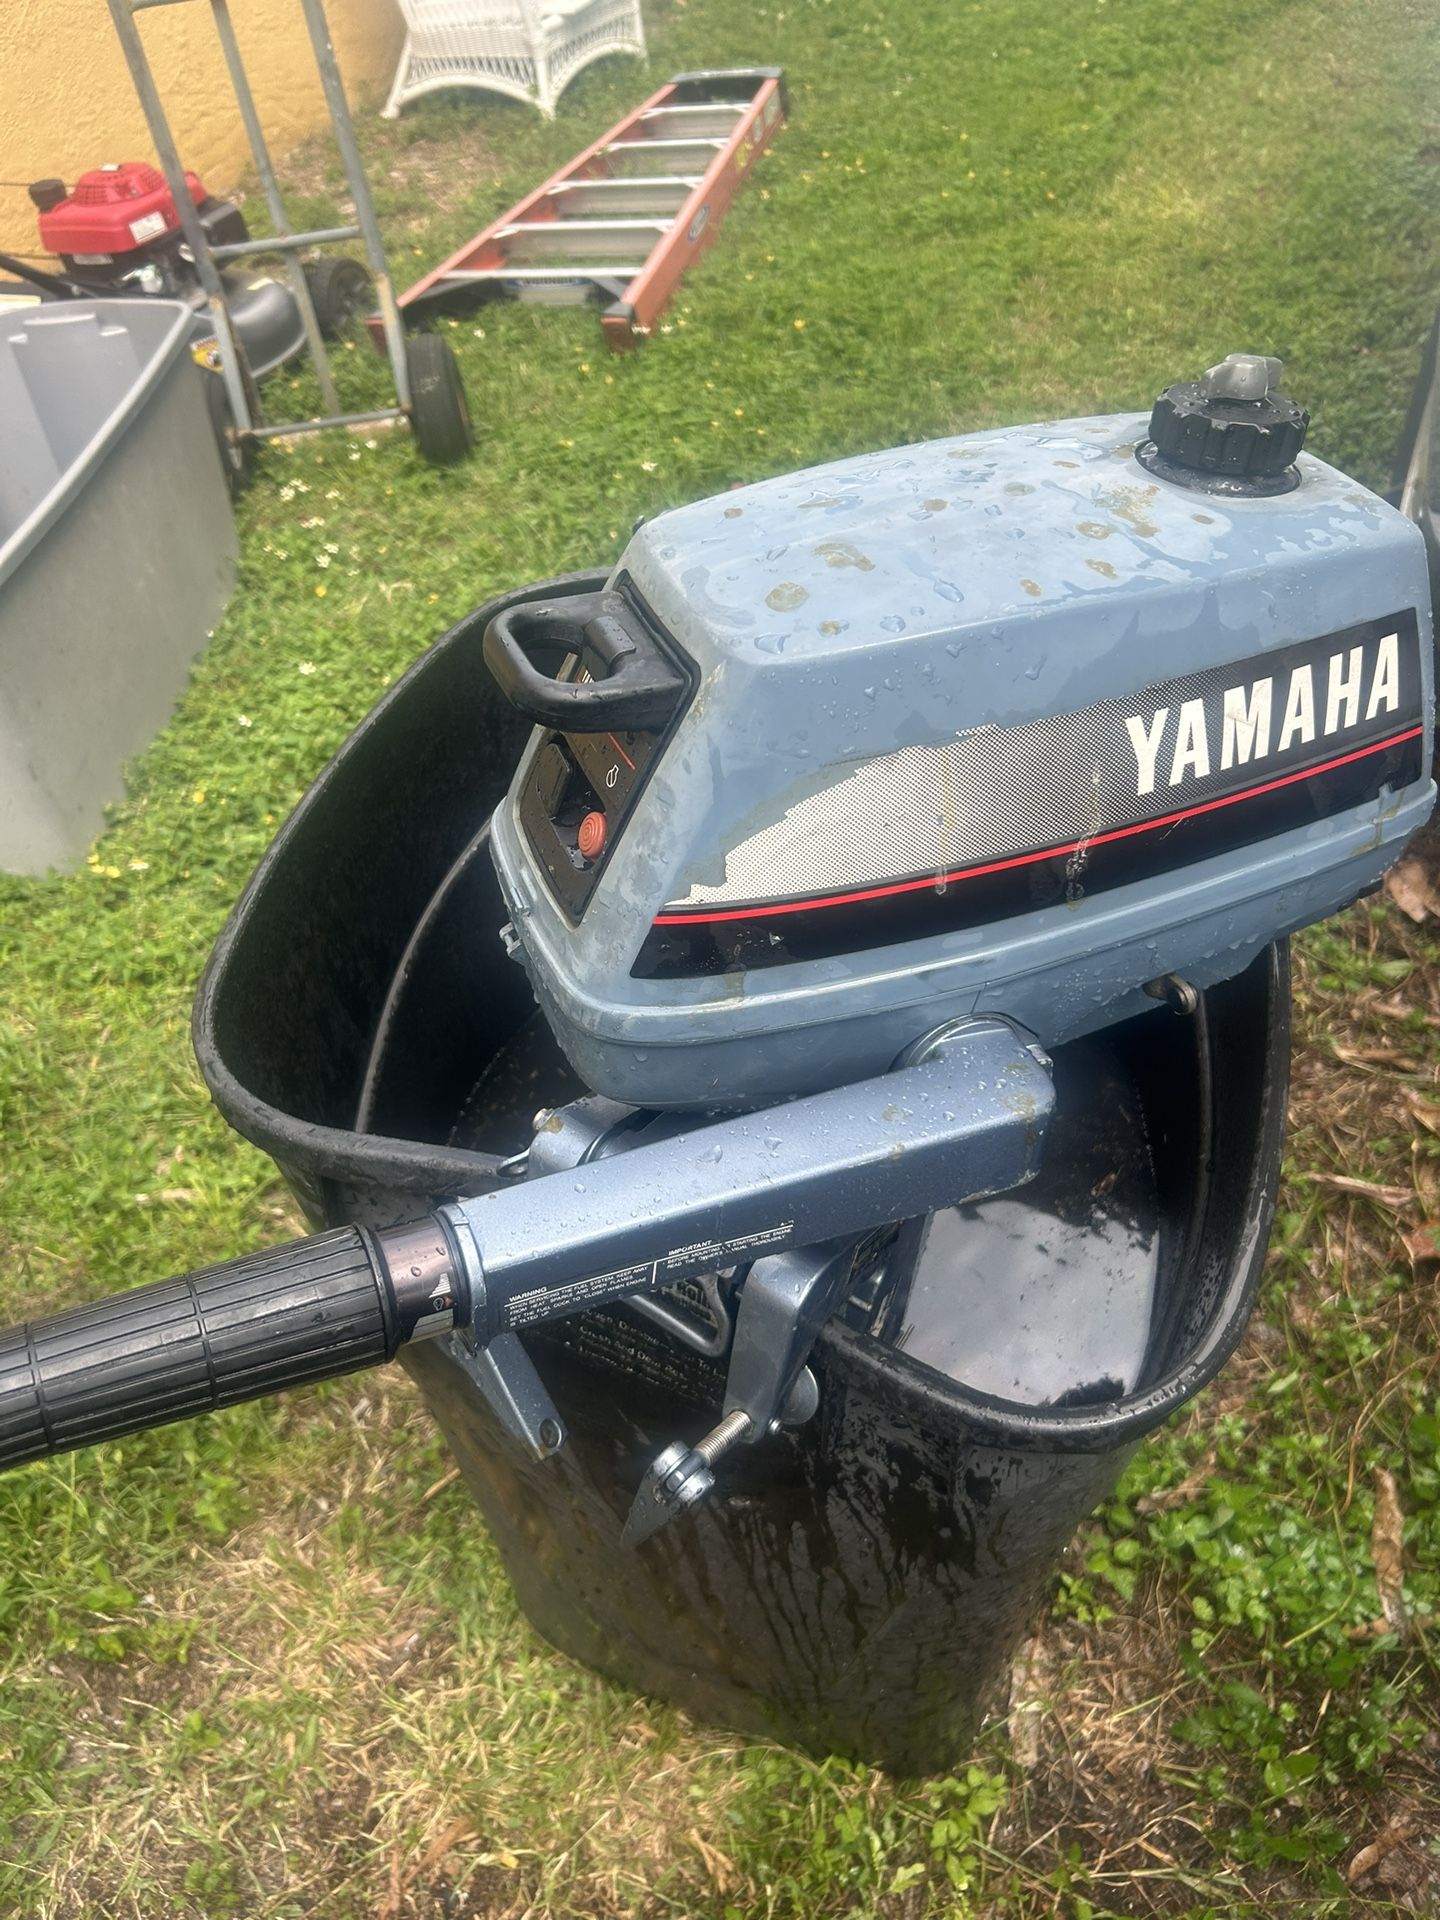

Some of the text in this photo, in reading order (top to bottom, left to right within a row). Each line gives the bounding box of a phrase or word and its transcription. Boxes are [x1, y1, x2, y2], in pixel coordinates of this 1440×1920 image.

[1125, 632, 1400, 797] YAMAHA
[667, 1255, 690, 1264] BEFORE
[691, 1246, 721, 1257] MOUNTING
[760, 1232, 772, 1240] THE
[772, 1227, 793, 1237] ENGINE
[668, 1239, 713, 1256] IMPORTANT
[667, 1261, 683, 1270] READ
[509, 1286, 547, 1302] WARNING
[510, 1302, 528, 1310] WHEN
[529, 1292, 560, 1304] SERVICING
[573, 1282, 588, 1290] FUEL
[616, 1270, 632, 1278] KEEP
[510, 1306, 528, 1316] FROM
[550, 1292, 573, 1303] SPARKS
[575, 1287, 589, 1296] AND
[591, 1282, 607, 1291] OPEN
[536, 1305, 551, 1313] FUEL
[553, 1299, 570, 1308] COCK
[607, 1283, 625, 1292] WHEN
[626, 1276, 647, 1287] ENGINE
[519, 1314, 539, 1324] TILTED
